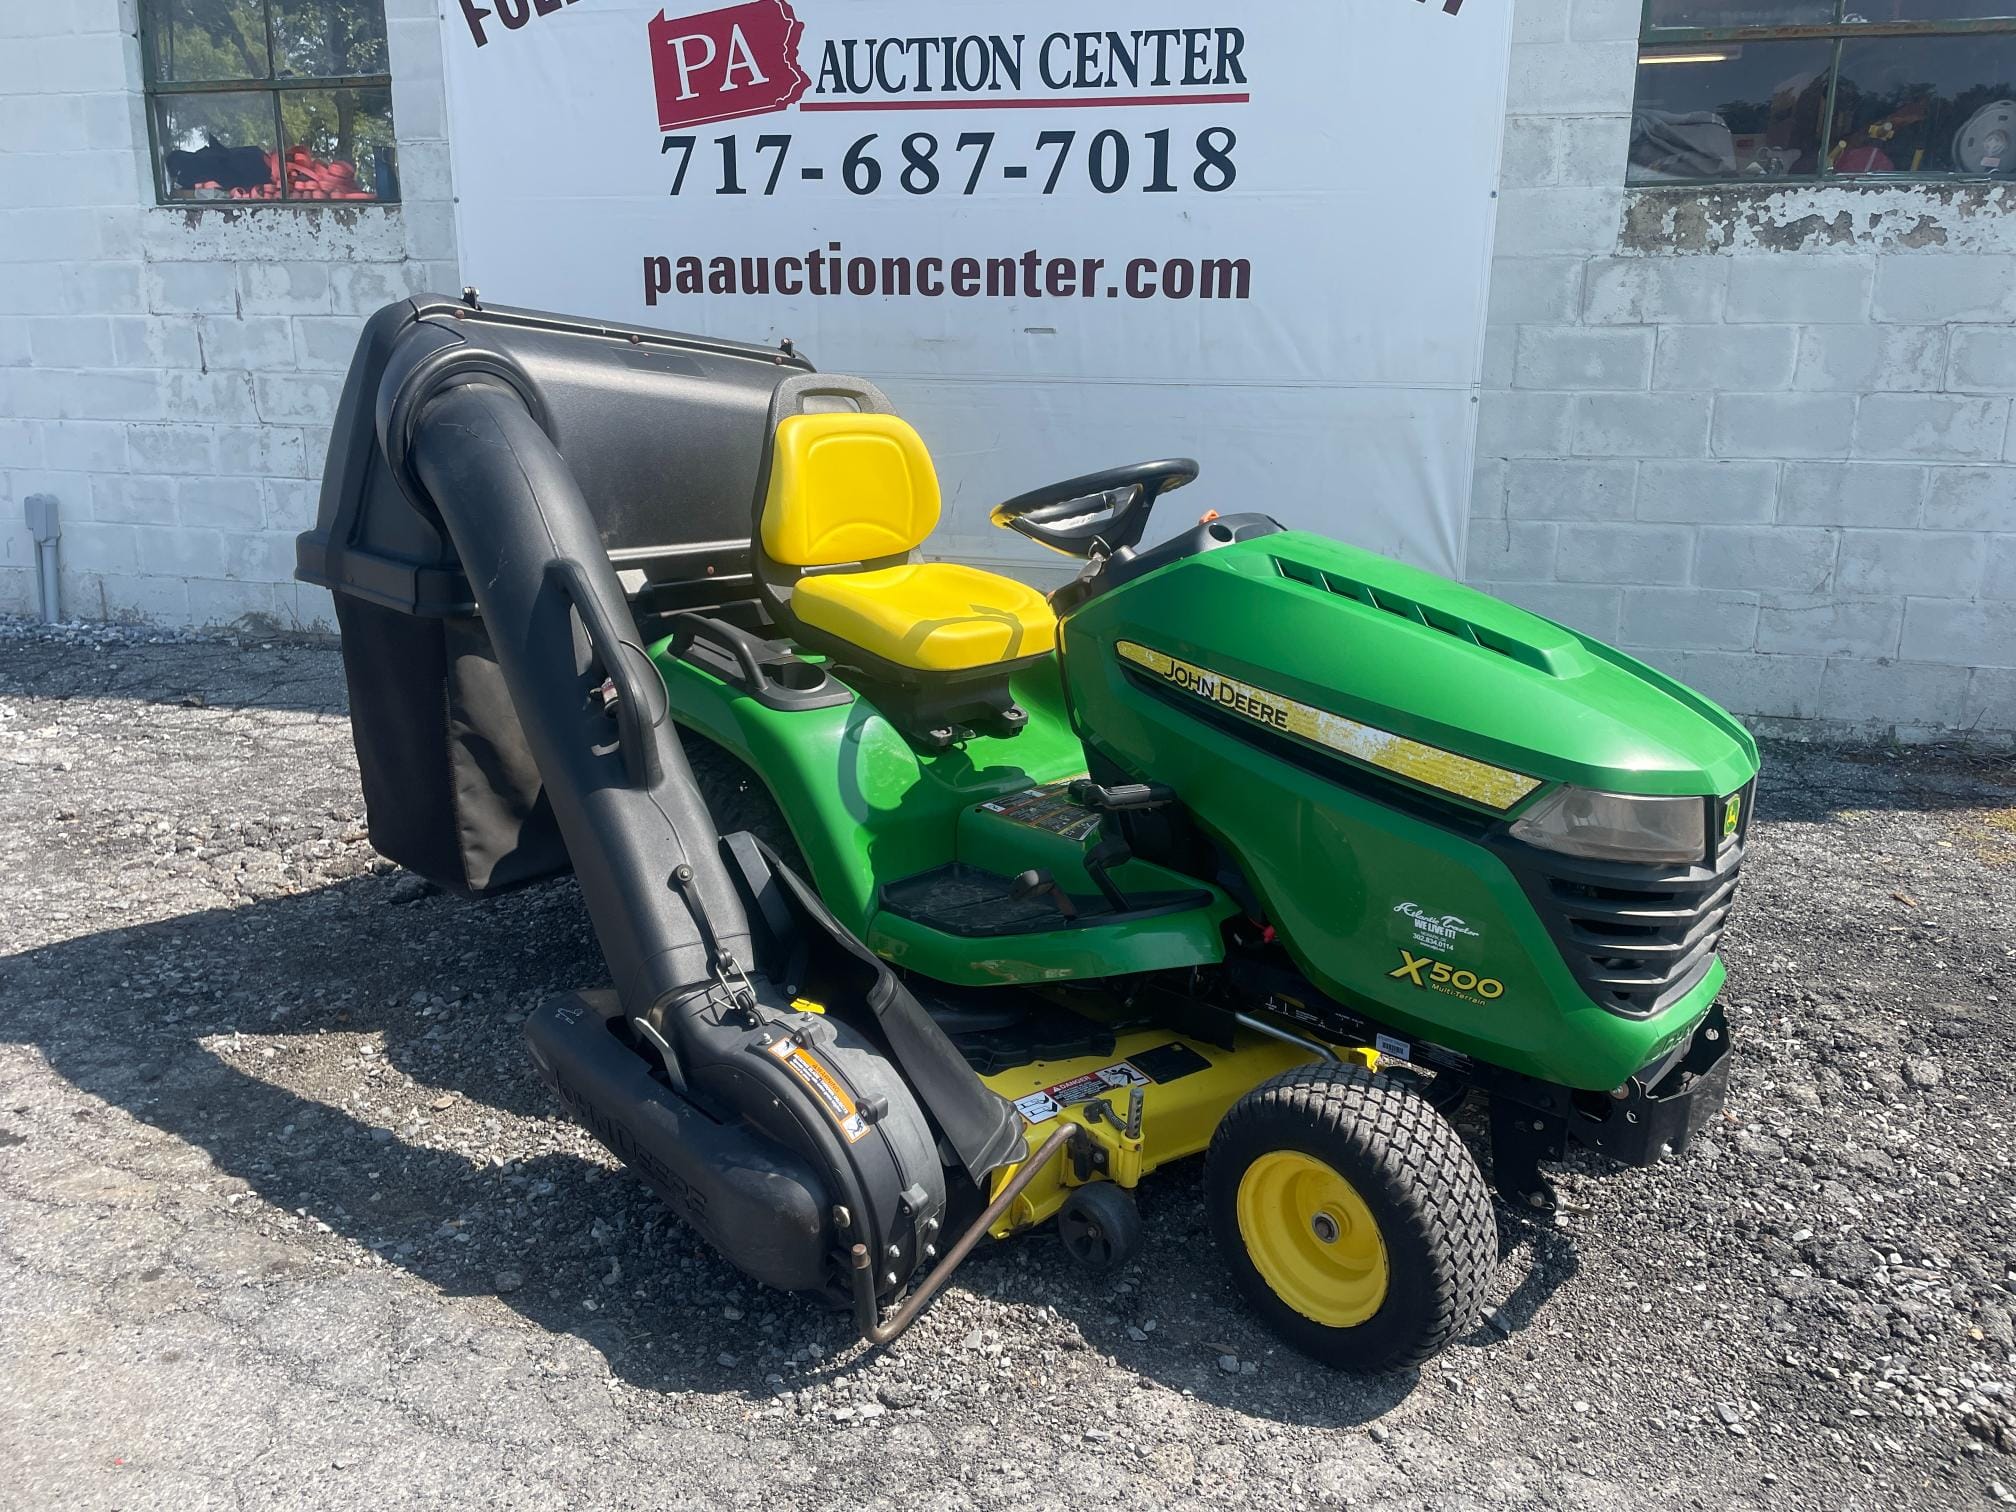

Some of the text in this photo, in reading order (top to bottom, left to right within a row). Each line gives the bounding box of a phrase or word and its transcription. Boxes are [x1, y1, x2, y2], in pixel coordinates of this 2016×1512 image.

[667, 23, 770, 101] PA
[815, 27, 1248, 94] AUCTION CENTER
[660, 126, 1237, 196] 717-687-7018
[643, 240, 1251, 306] paauctioncenter.com
[1164, 660, 1289, 729] JOHN DEERE
[1414, 918, 1428, 931] WE
[1427, 921, 1446, 936] LIVE
[1386, 948, 1505, 1000] X500
[1431, 983, 1487, 1006] Multi-Terrain
[1059, 1075, 1091, 1089] DANGER
